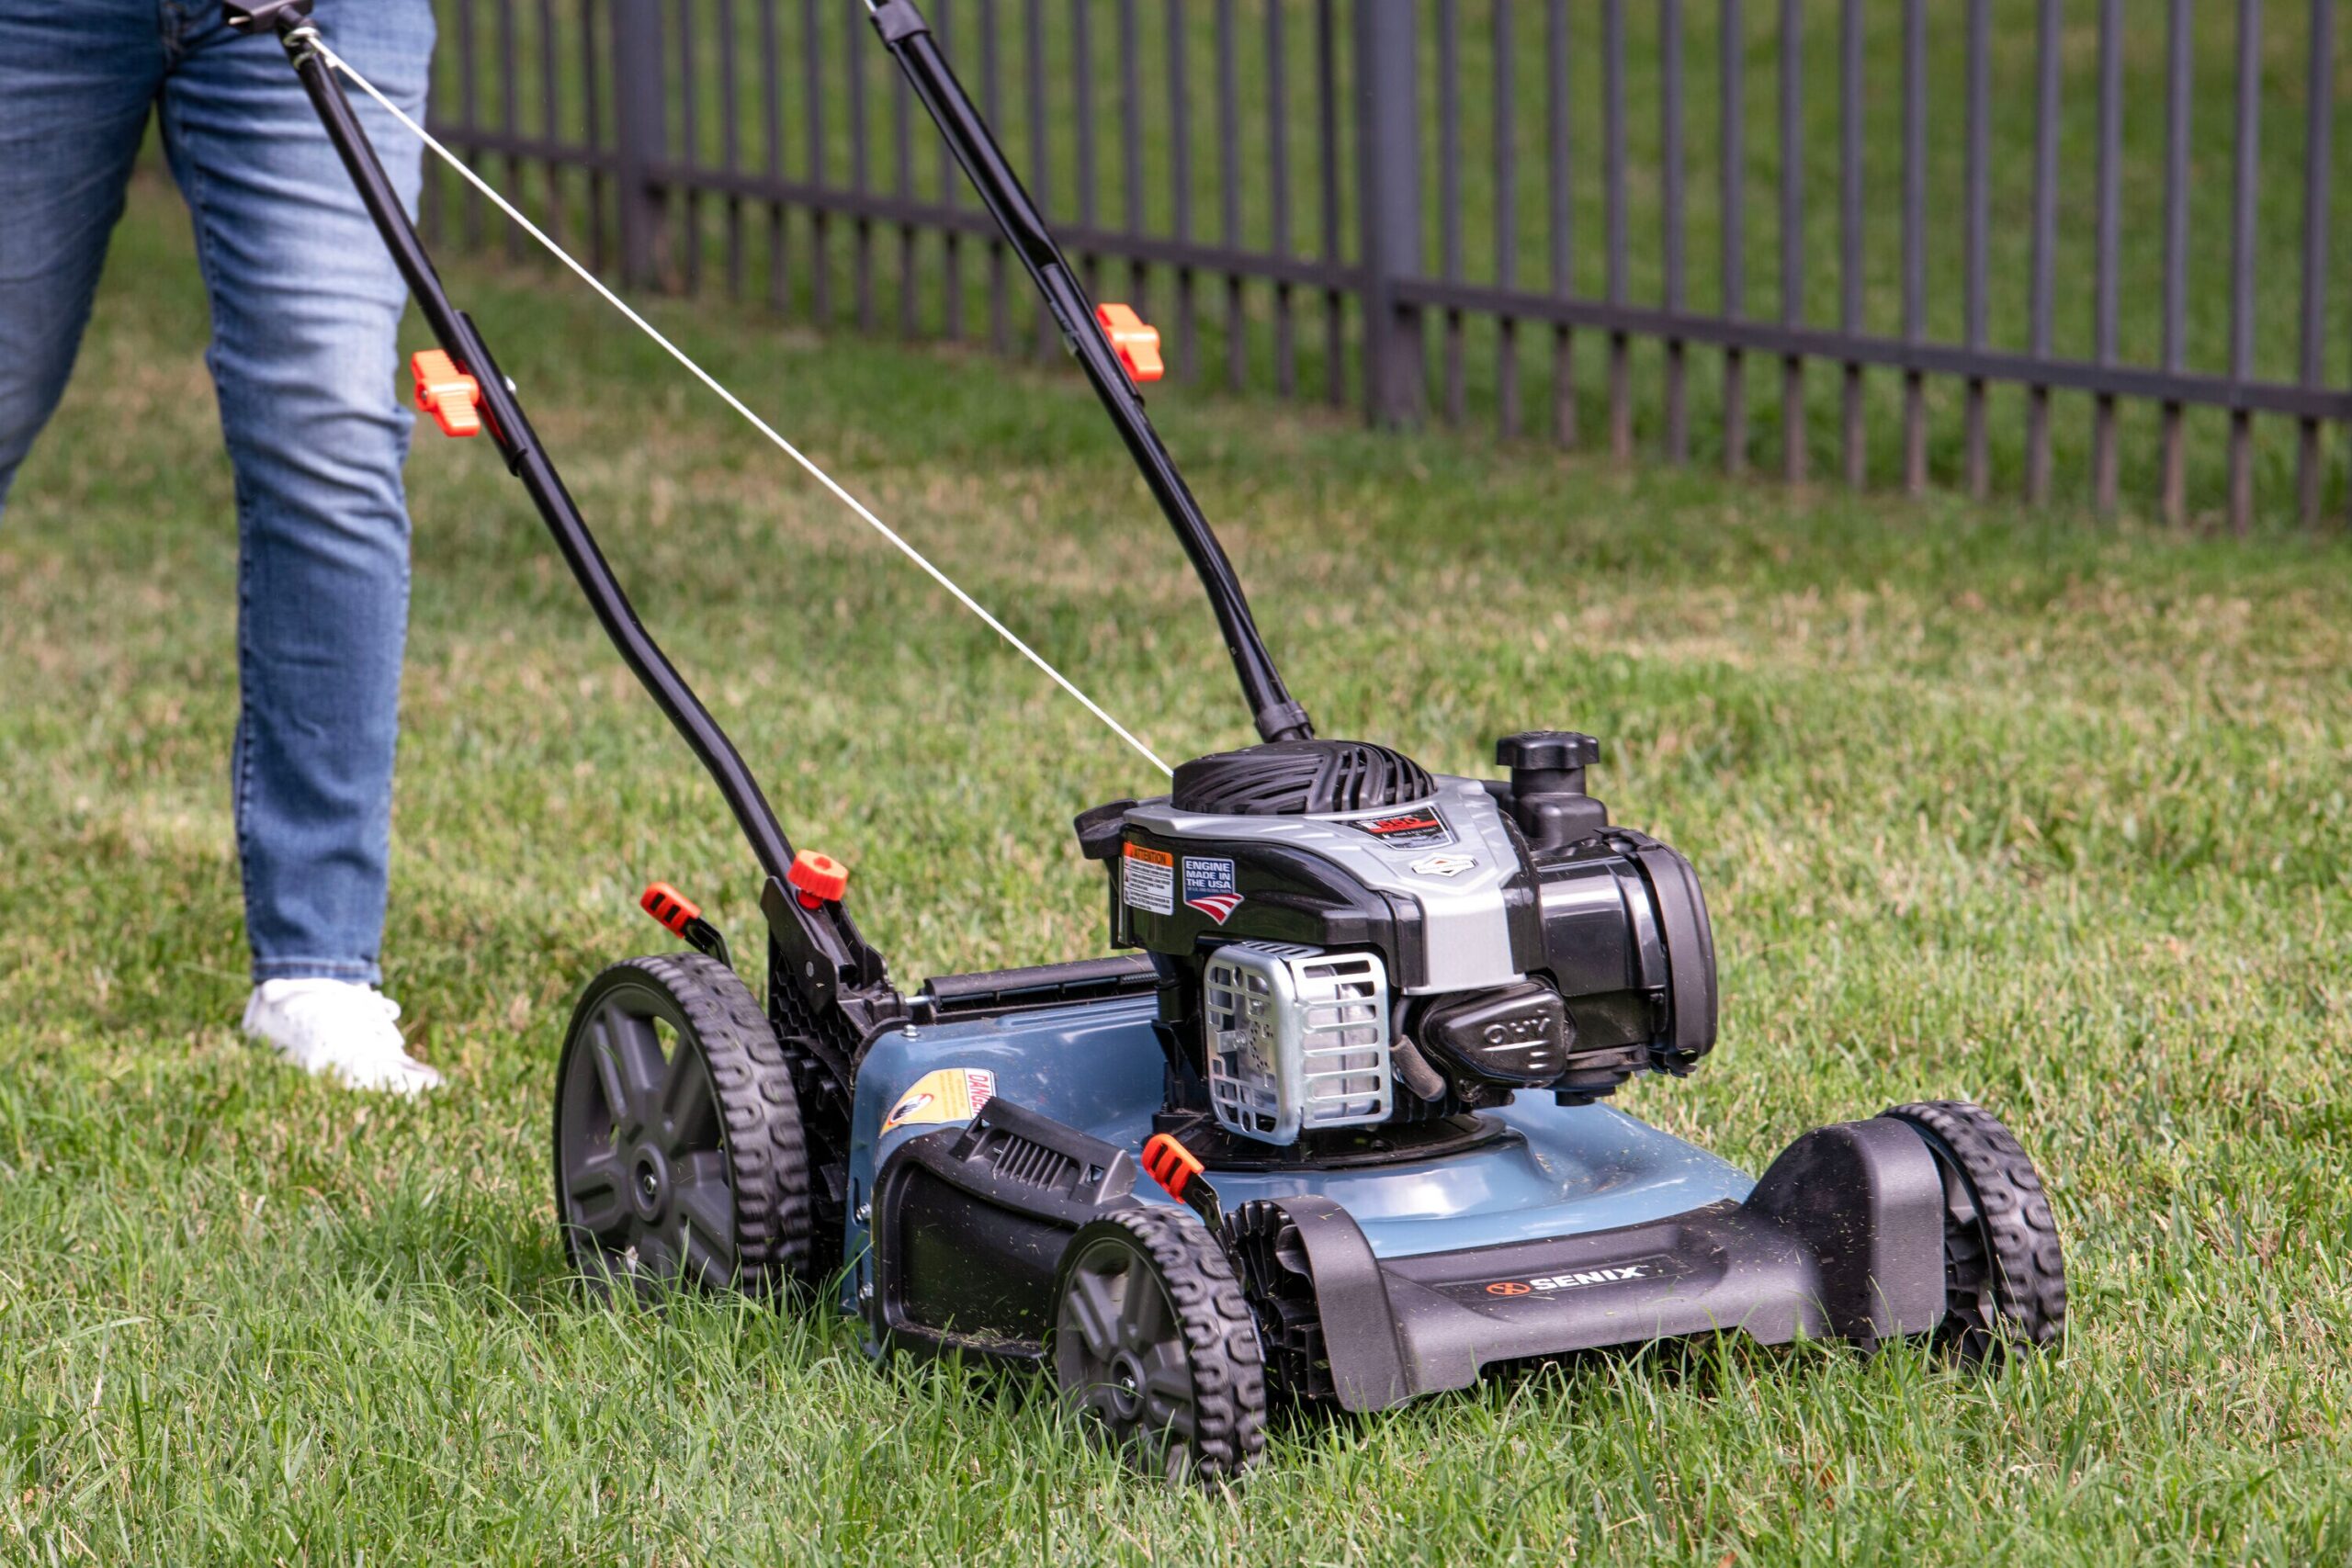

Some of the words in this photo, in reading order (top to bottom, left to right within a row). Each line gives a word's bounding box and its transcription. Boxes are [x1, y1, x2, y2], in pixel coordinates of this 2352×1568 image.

[1185, 860, 1231, 872] ENGINE
[1186, 870, 1216, 880] MADE
[1218, 872, 1231, 881] IN
[1186, 878, 1205, 887] THE
[1207, 880, 1232, 889] USA
[968, 1074, 991, 1115] DANGE
[1529, 1266, 1646, 1290] SENIX
